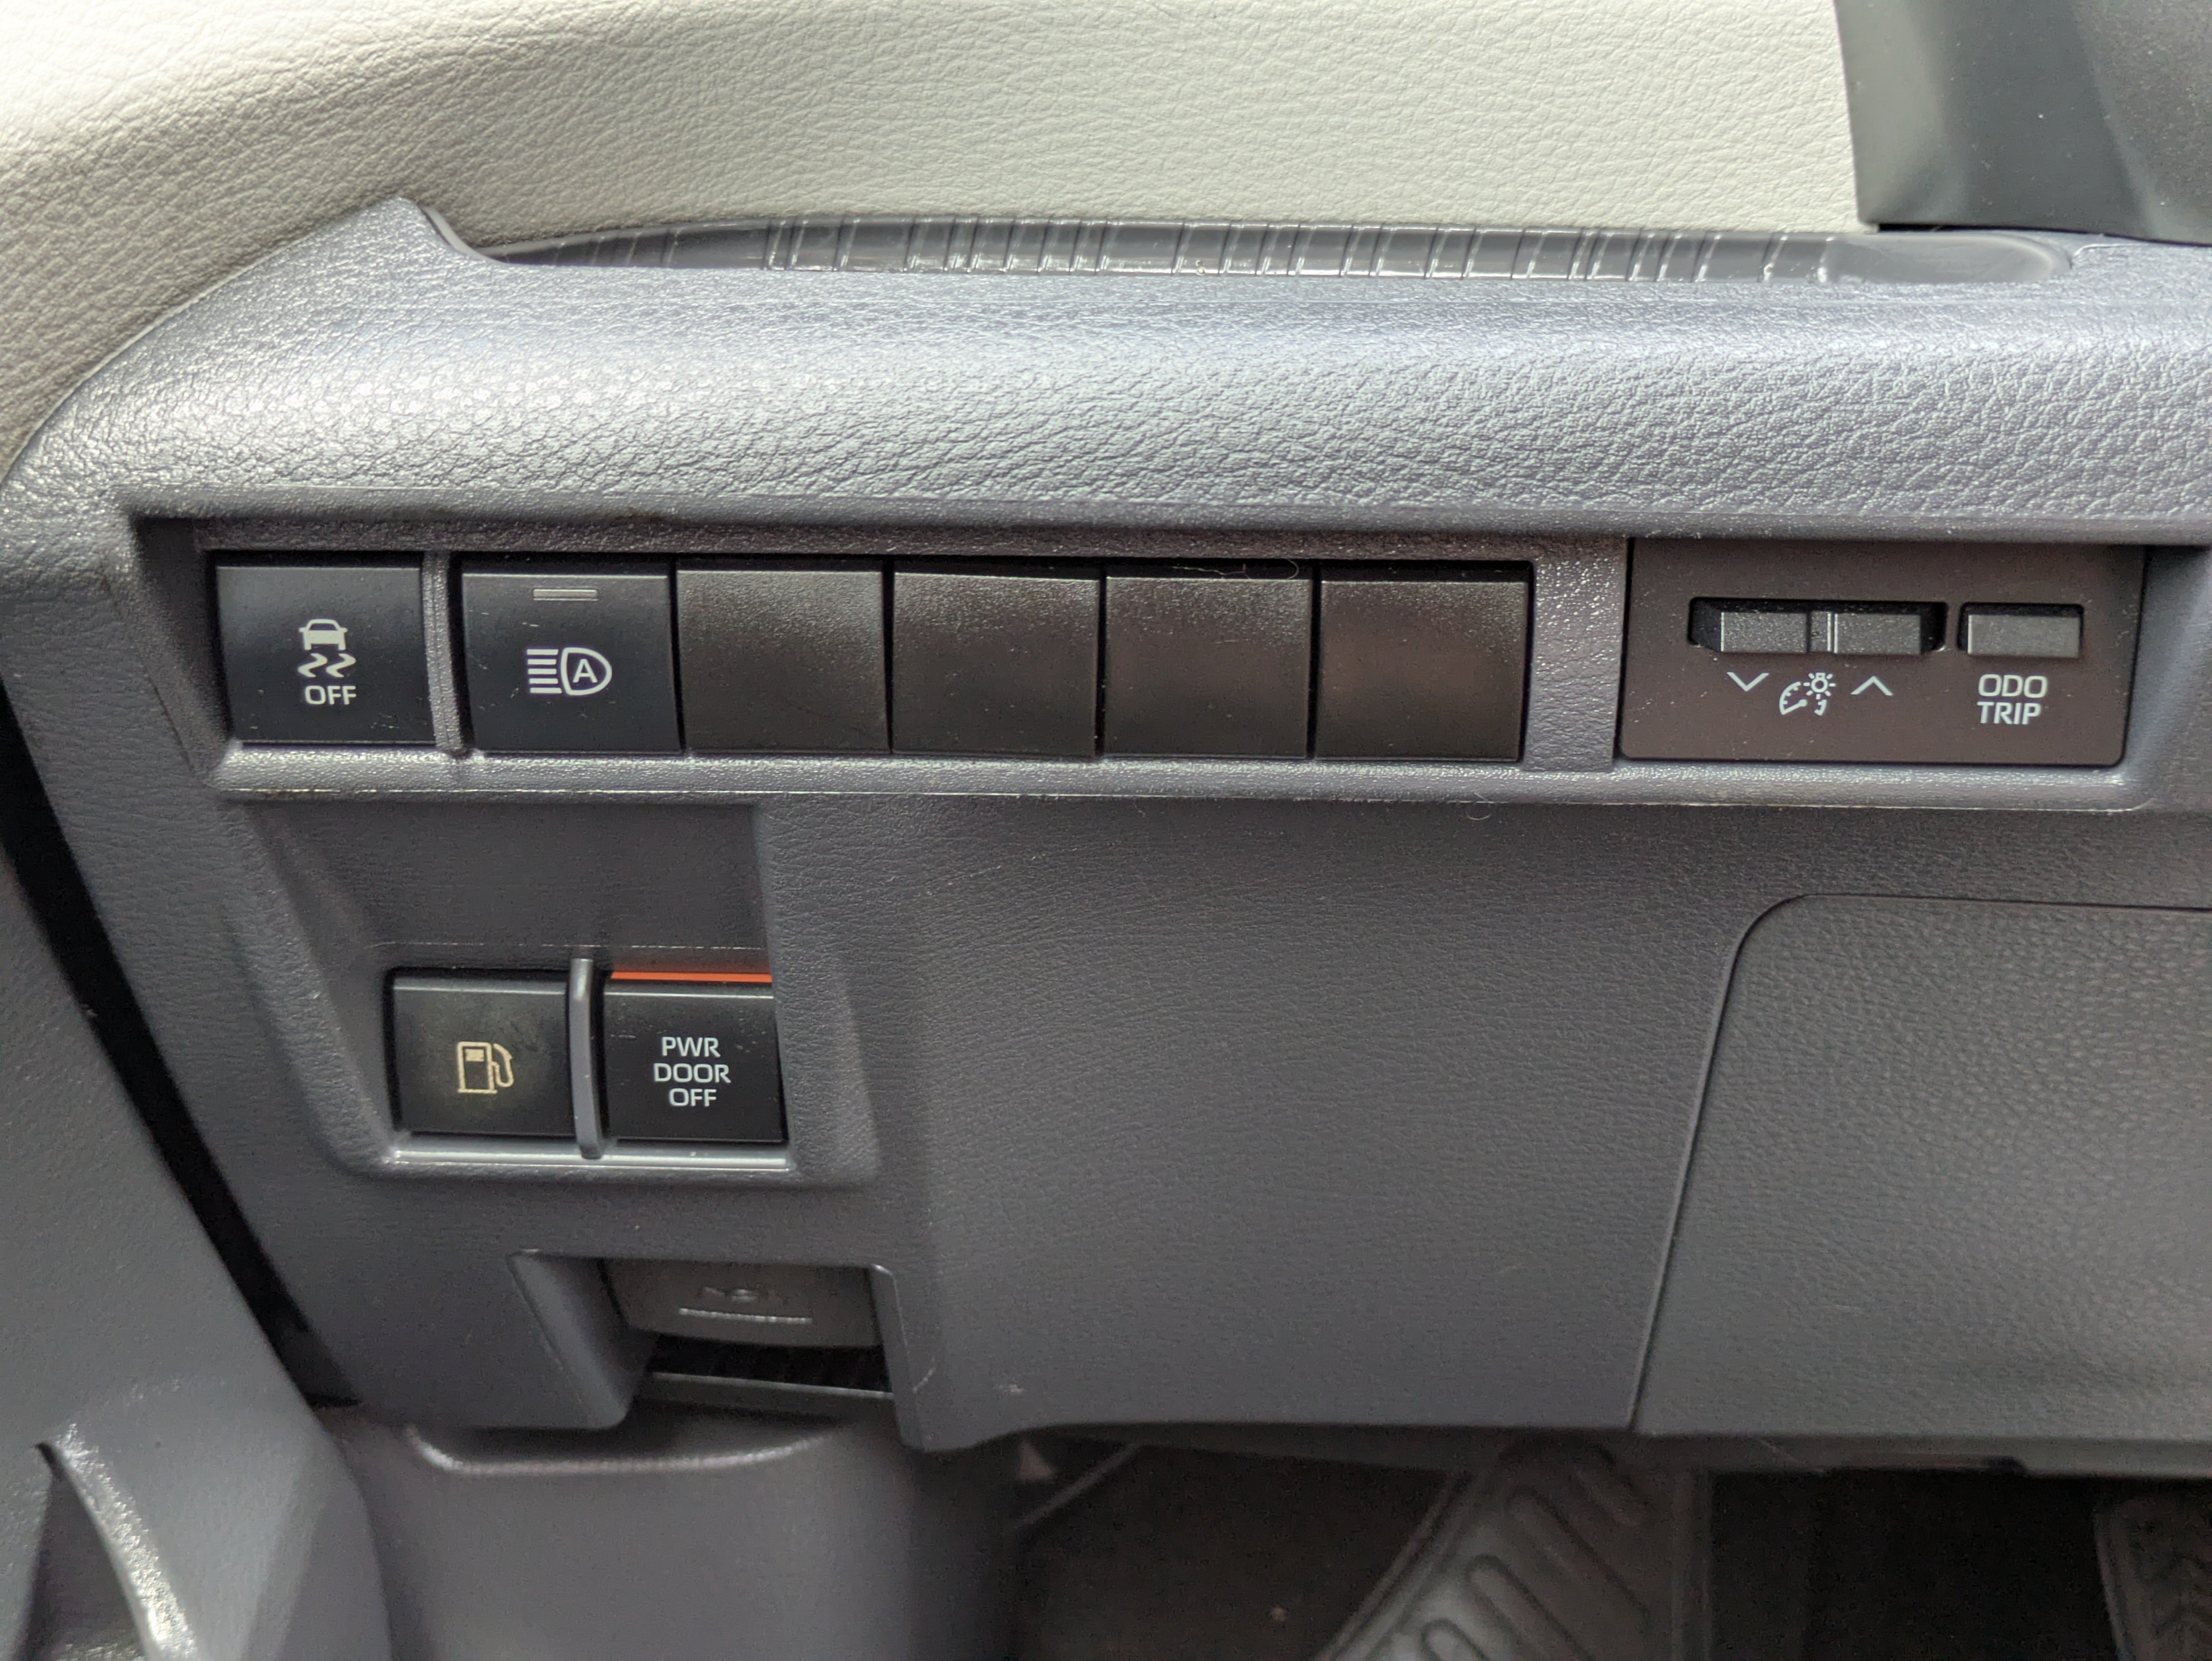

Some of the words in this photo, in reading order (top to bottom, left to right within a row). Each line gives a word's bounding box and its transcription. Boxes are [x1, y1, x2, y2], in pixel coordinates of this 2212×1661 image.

[573, 658, 598, 683] A
[304, 685, 356, 705] OFF
[1978, 674, 2047, 698] ODO
[1977, 701, 2041, 725] TRIP
[662, 1036, 721, 1057] PWR
[653, 1063, 731, 1083] DOOR
[669, 1088, 717, 1107] OFF
